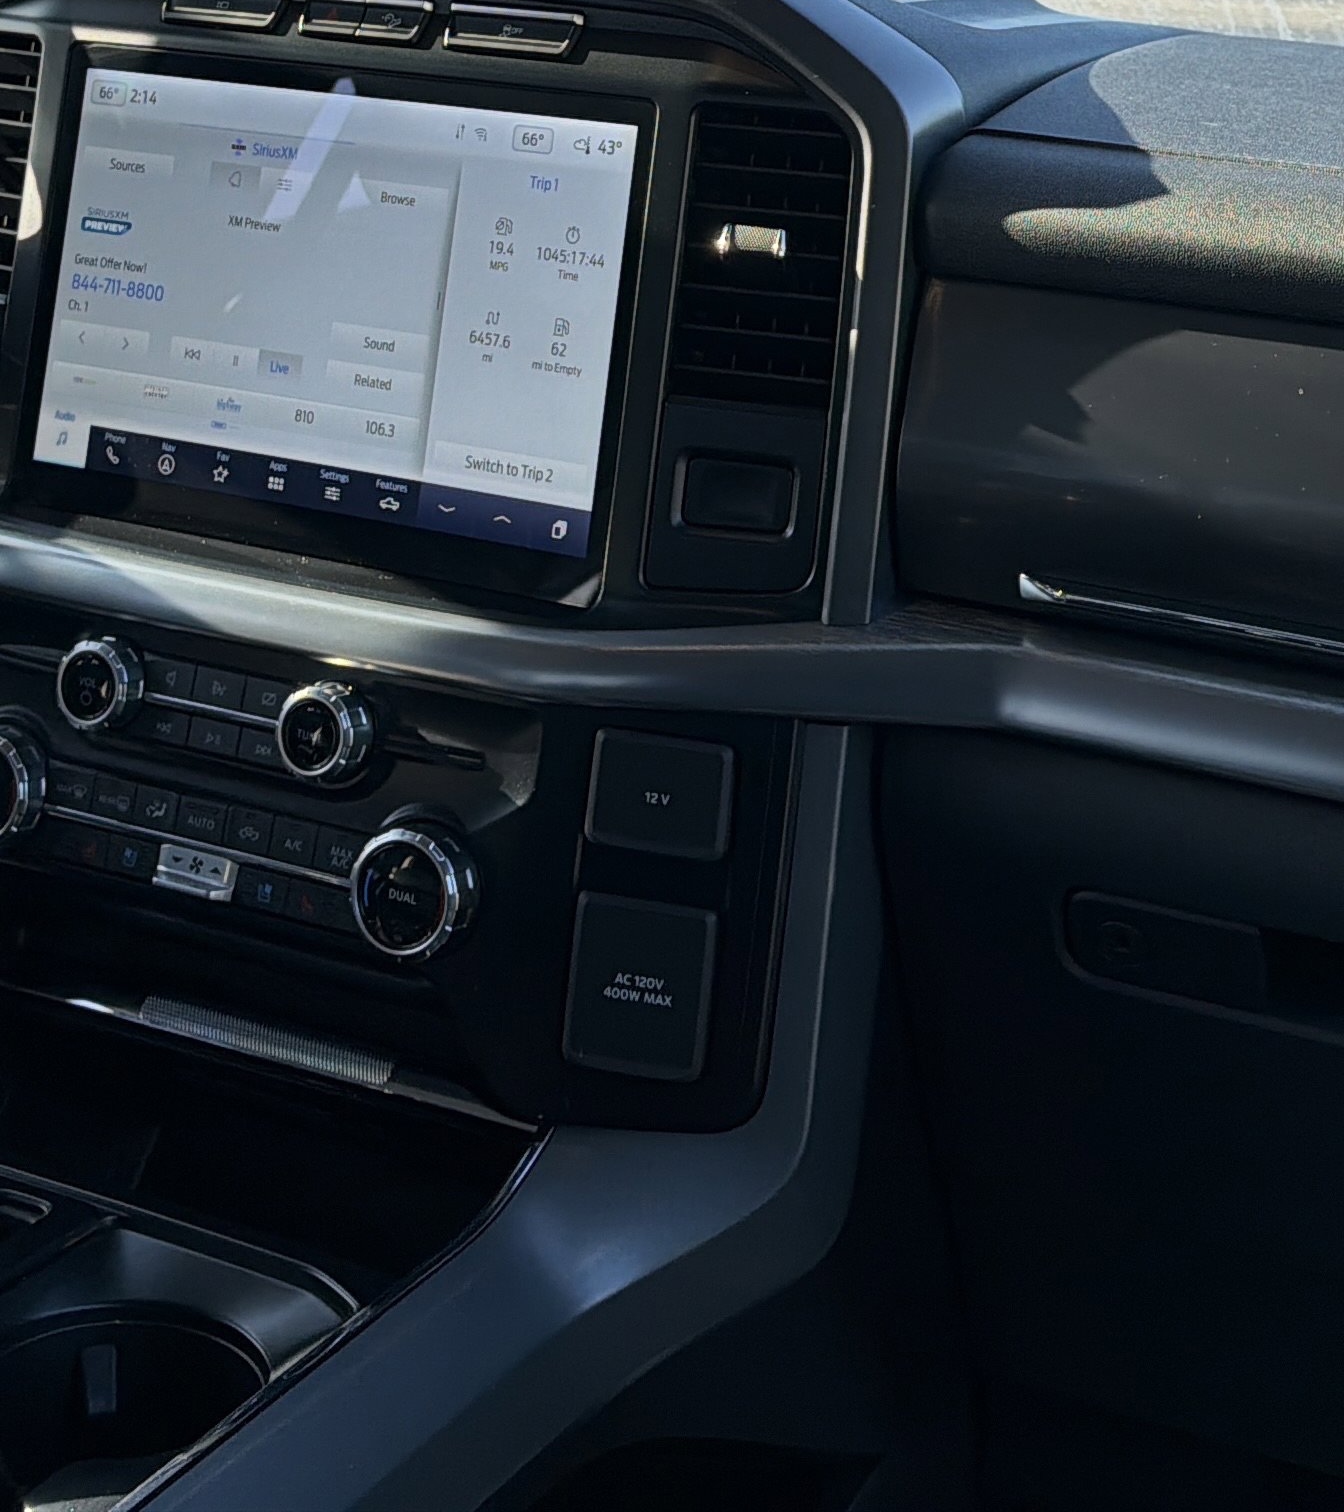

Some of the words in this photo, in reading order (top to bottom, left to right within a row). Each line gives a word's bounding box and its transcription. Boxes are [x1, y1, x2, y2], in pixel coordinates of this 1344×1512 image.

[129, 88, 157, 105] 2:14
[521, 132, 544, 147] 66°
[252, 142, 299, 160] SiriusXM
[597, 140, 623, 156] 43°
[109, 158, 146, 174] Sources
[530, 175, 551, 192] Trip
[380, 191, 416, 207] Browse
[87, 206, 129, 220] SIRIUSXM
[228, 215, 244, 228] XM
[244, 217, 282, 233] Preview
[489, 240, 514, 256] 19.4
[74, 253, 98, 268] Great
[100, 256, 122, 271] Offer
[123, 259, 148, 274] Now!
[536, 246, 605, 269] 1045:17:44
[489, 261, 509, 272] MPG
[558, 269, 579, 282] Time
[71, 273, 165, 302] 844-711-8800
[68, 299, 82, 311] Ch.
[363, 337, 395, 353] Sound
[469, 330, 511, 349] 6457.6
[482, 352, 493, 363] mi
[551, 342, 567, 358] 62
[269, 360, 290, 375] Live
[531, 360, 543, 371] mi
[544, 361, 553, 372] to
[554, 363, 583, 378] Empty
[354, 374, 392, 391] Related
[55, 410, 76, 422] Audio
[294, 409, 315, 424] 810
[365, 420, 396, 438] 106.3
[105, 433, 126, 445] Phone
[161, 442, 176, 454] Nav
[216, 451, 231, 463] Fav
[269, 460, 288, 473] Apps
[465, 455, 504, 474] Switch
[506, 462, 519, 476] to
[520, 464, 544, 483] Trip
[547, 468, 554, 483] 2
[319, 469, 350, 484] Settings
[375, 479, 408, 494] Features
[644, 792, 659, 805] 12
[659, 794, 671, 806] V
[187, 815, 216, 831] AUTO
[283, 836, 304, 853] A/C
[387, 888, 417, 906] DUAL
[614, 972, 632, 986] AC
[634, 975, 665, 991] 120V
[603, 986, 641, 1002] 400W
[644, 992, 673, 1008] MAX
